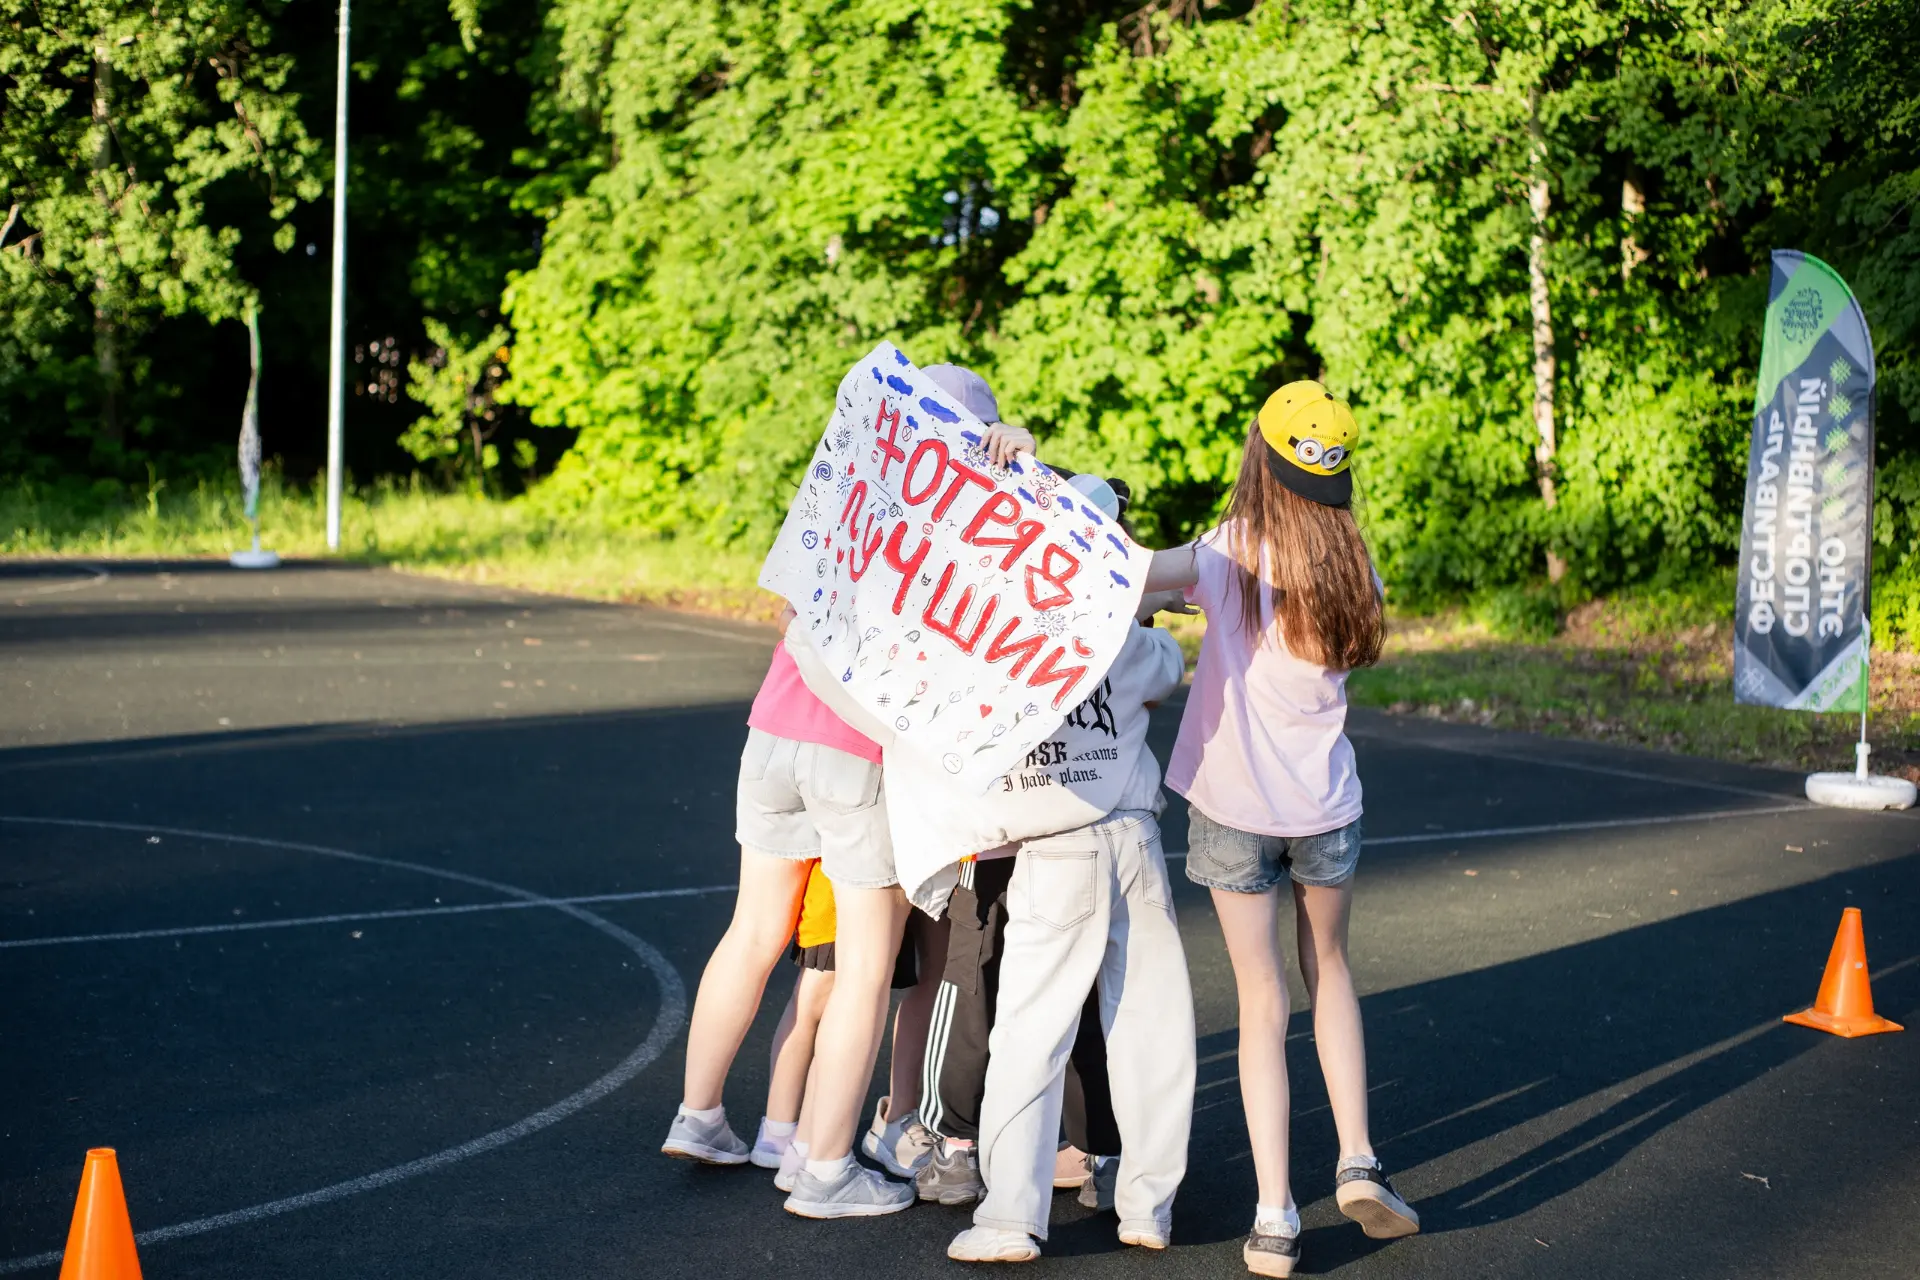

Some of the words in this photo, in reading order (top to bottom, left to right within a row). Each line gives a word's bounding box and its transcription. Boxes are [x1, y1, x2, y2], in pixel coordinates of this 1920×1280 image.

[840, 479, 1095, 712] ЛУЧШИЙ
[1019, 771, 1053, 793] have
[1059, 766, 1103, 788] plans.
